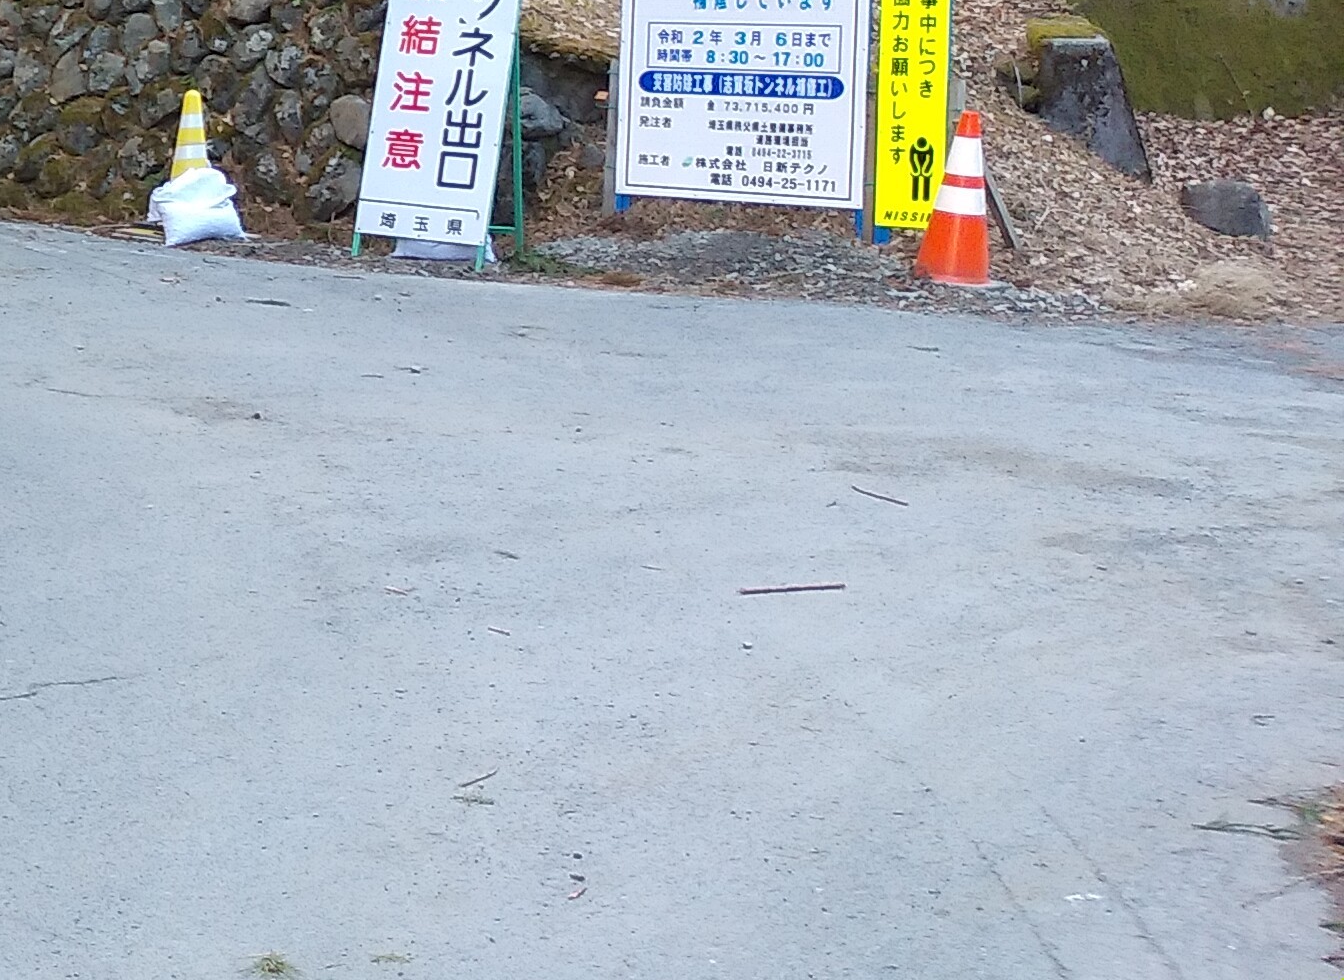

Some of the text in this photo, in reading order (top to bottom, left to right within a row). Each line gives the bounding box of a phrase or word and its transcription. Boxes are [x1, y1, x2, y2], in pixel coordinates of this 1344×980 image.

[657, 29, 683, 45] 令和
[734, 31, 761, 47] 3月
[775, 32, 831, 48] 6日まで
[656, 48, 692, 63] 時間帯
[639, 115, 672, 128] 発注者
[695, 157, 747, 171] 株式会社
[763, 161, 828, 175] 日新テクノ
[710, 173, 836, 192] 電話 0494-25-1171
[379, 212, 463, 236] 埼玉県
